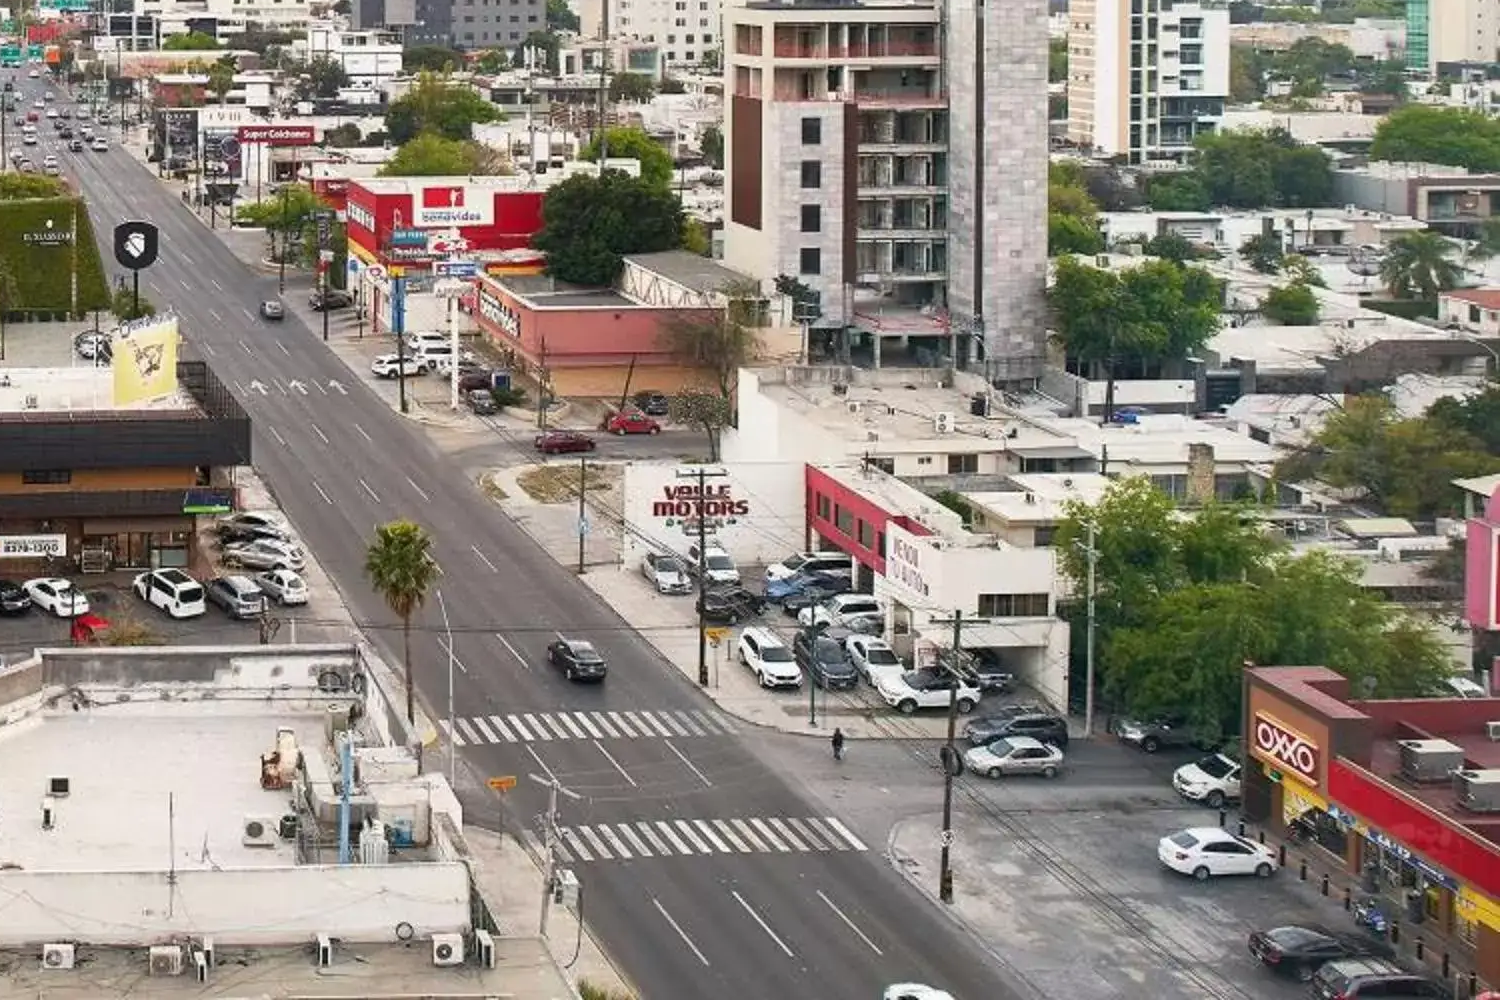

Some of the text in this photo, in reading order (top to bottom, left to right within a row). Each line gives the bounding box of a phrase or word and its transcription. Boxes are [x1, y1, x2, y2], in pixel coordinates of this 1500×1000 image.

[243, 129, 311, 140] Super Colchones
[663, 484, 731, 500] VALLE
[653, 499, 749, 517] MOTORS
[1257, 722, 1315, 773] OXXO
